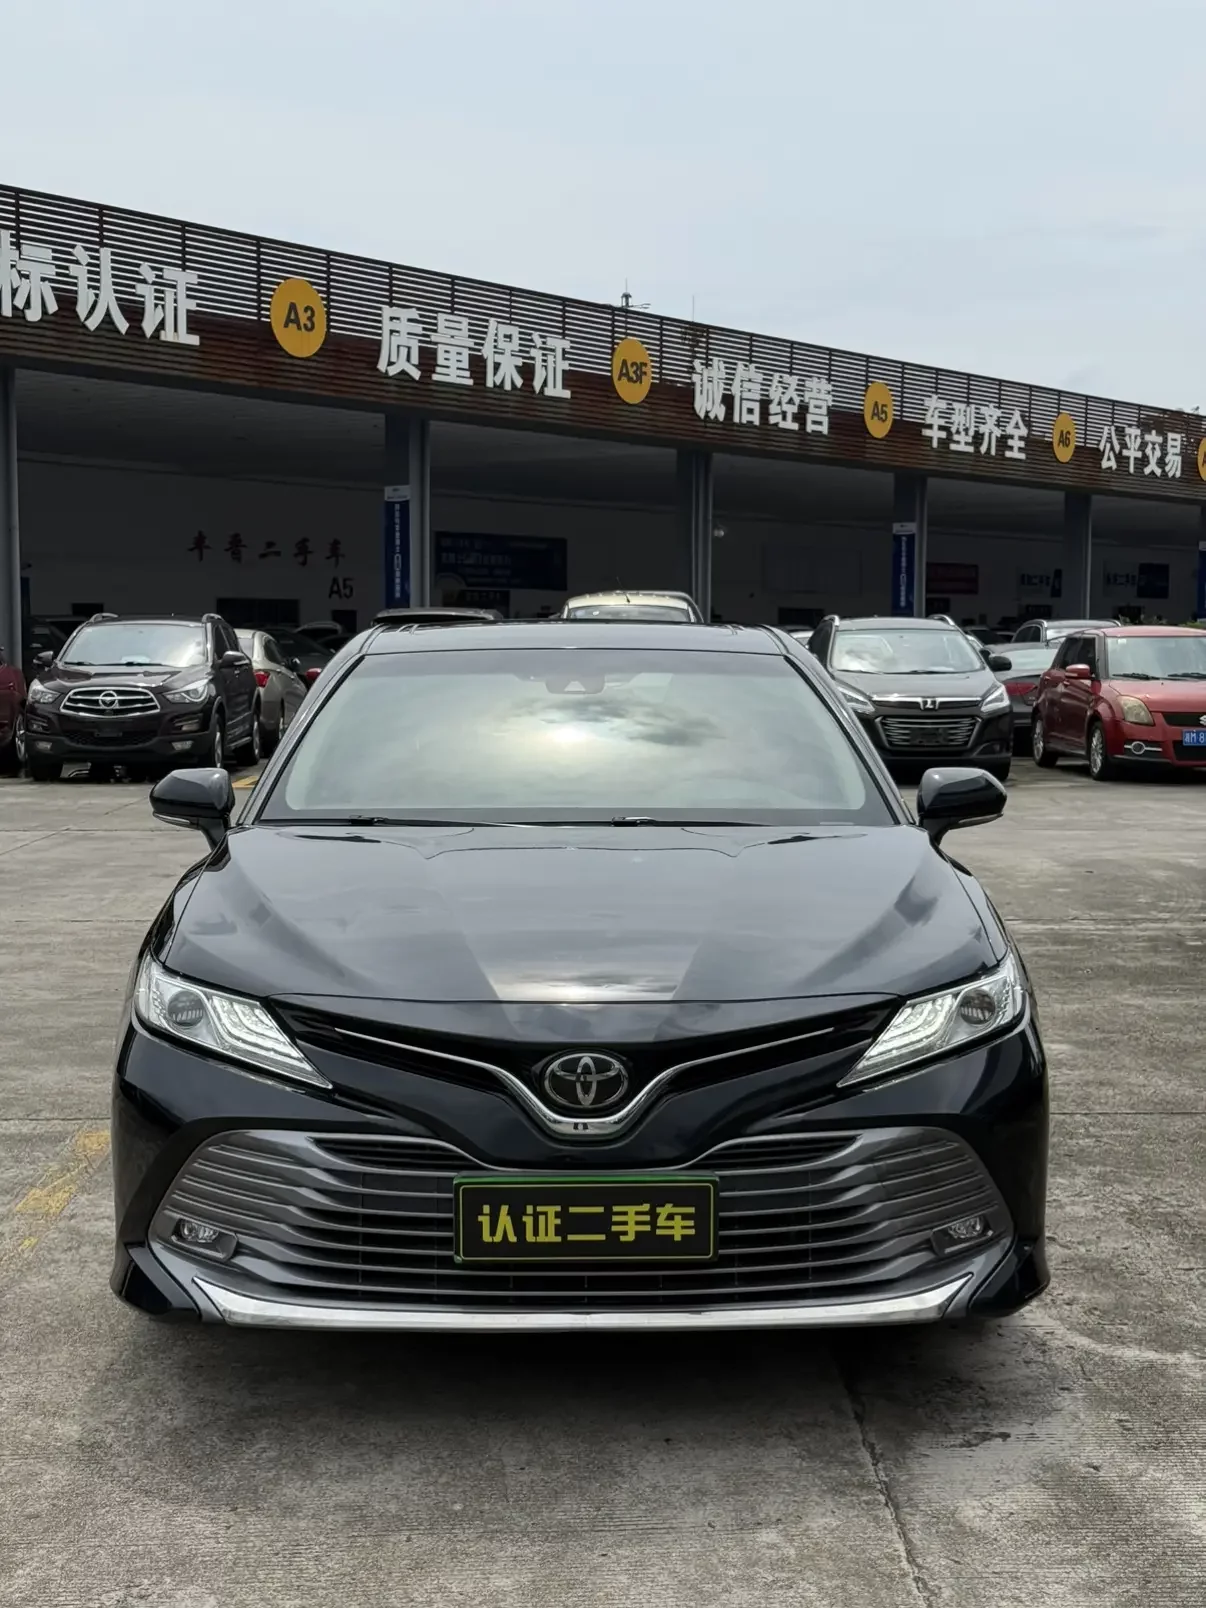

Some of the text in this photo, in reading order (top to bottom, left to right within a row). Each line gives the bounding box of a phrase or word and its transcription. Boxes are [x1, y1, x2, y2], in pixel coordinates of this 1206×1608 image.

[0, 229, 200, 346] 标认证
[283, 301, 316, 332] A3
[376, 306, 572, 399] 质量保证
[617, 358, 648, 386] A3F
[691, 357, 833, 436] 诚信经营
[870, 400, 889, 423] A5
[921, 394, 1029, 460] 车型齐全
[1057, 430, 1071, 448] A6
[1099, 425, 1182, 478] 公平交易
[328, 576, 355, 599] A5
[477, 1203, 696, 1243] 认证二手车
